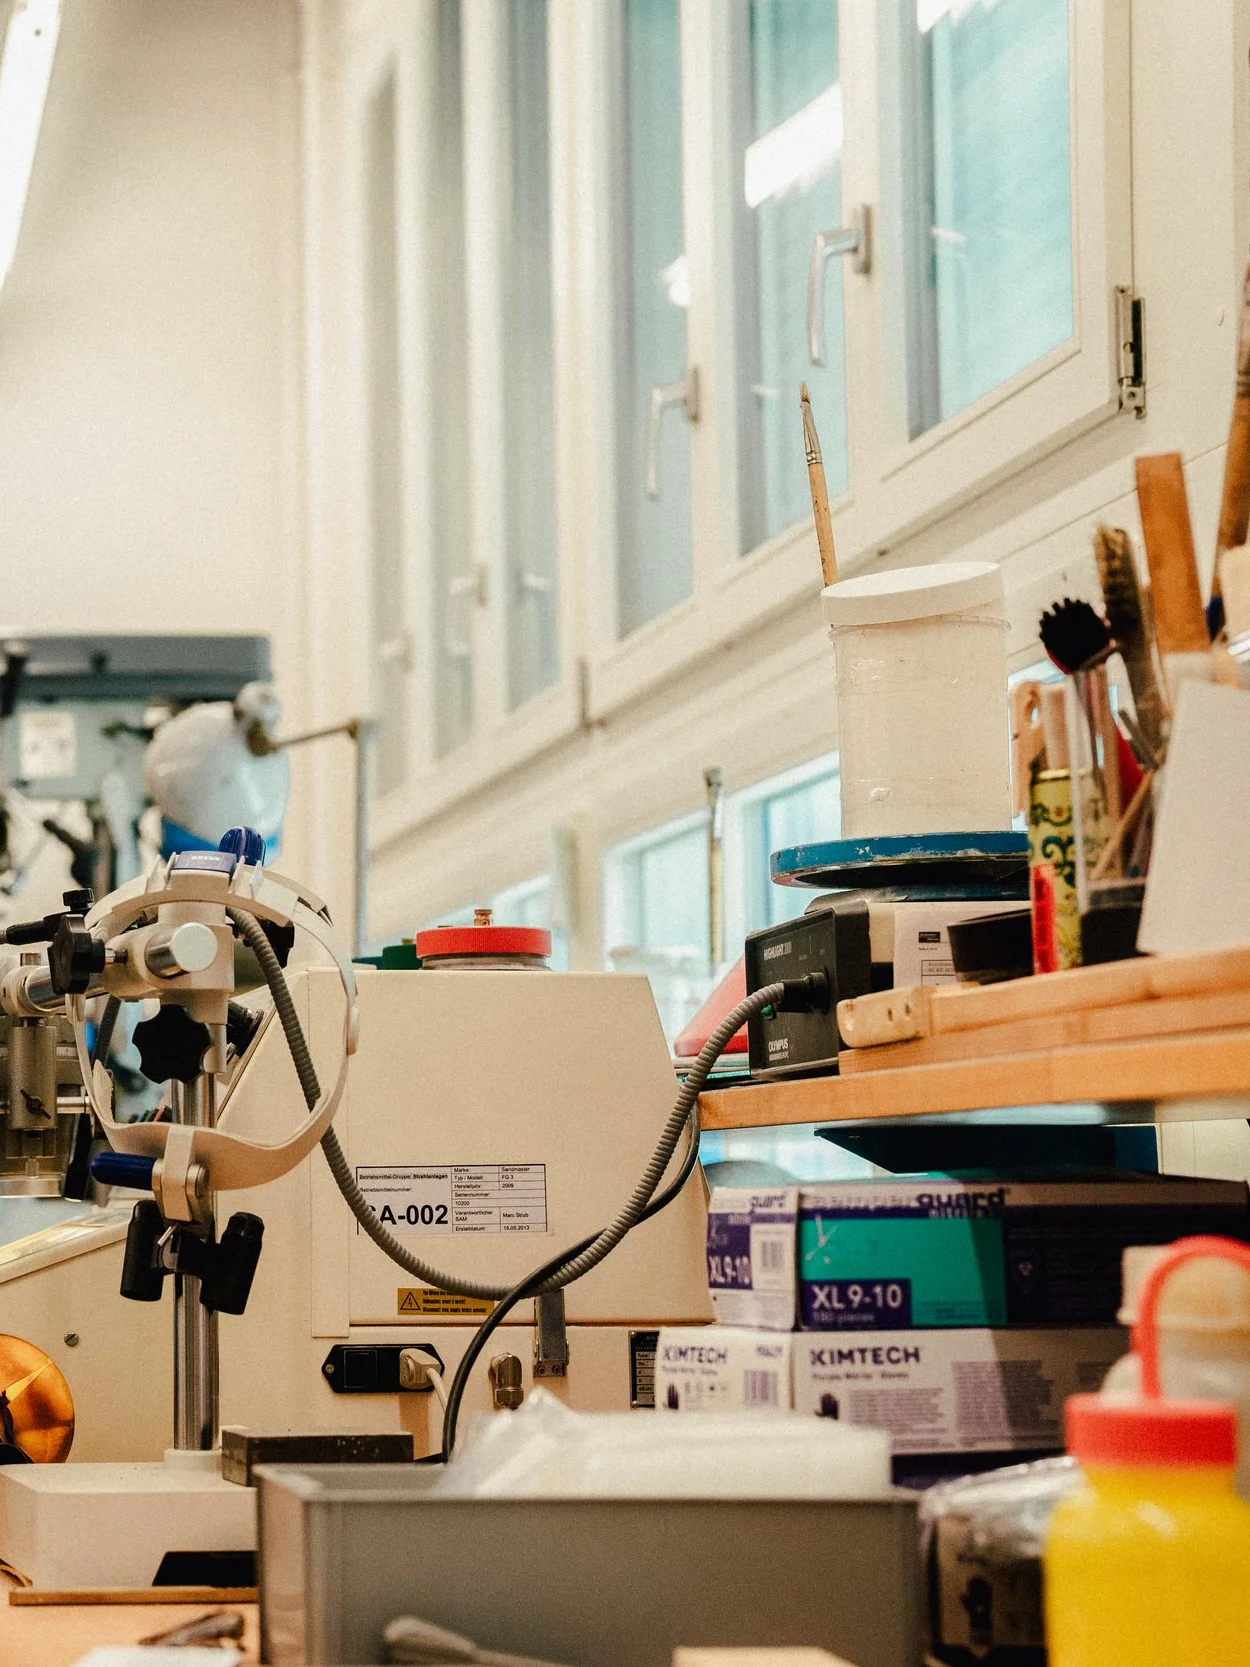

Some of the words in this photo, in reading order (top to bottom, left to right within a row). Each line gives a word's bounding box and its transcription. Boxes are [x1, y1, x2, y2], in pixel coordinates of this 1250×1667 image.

[768, 1038, 789, 1053] OLYMPUS
[369, 1204, 449, 1226] A-002
[811, 1284, 845, 1310] XL
[847, 1283, 903, 1310] 9-10
[664, 1345, 728, 1364] KIMTECH
[810, 1346, 921, 1366] KIMTECH
